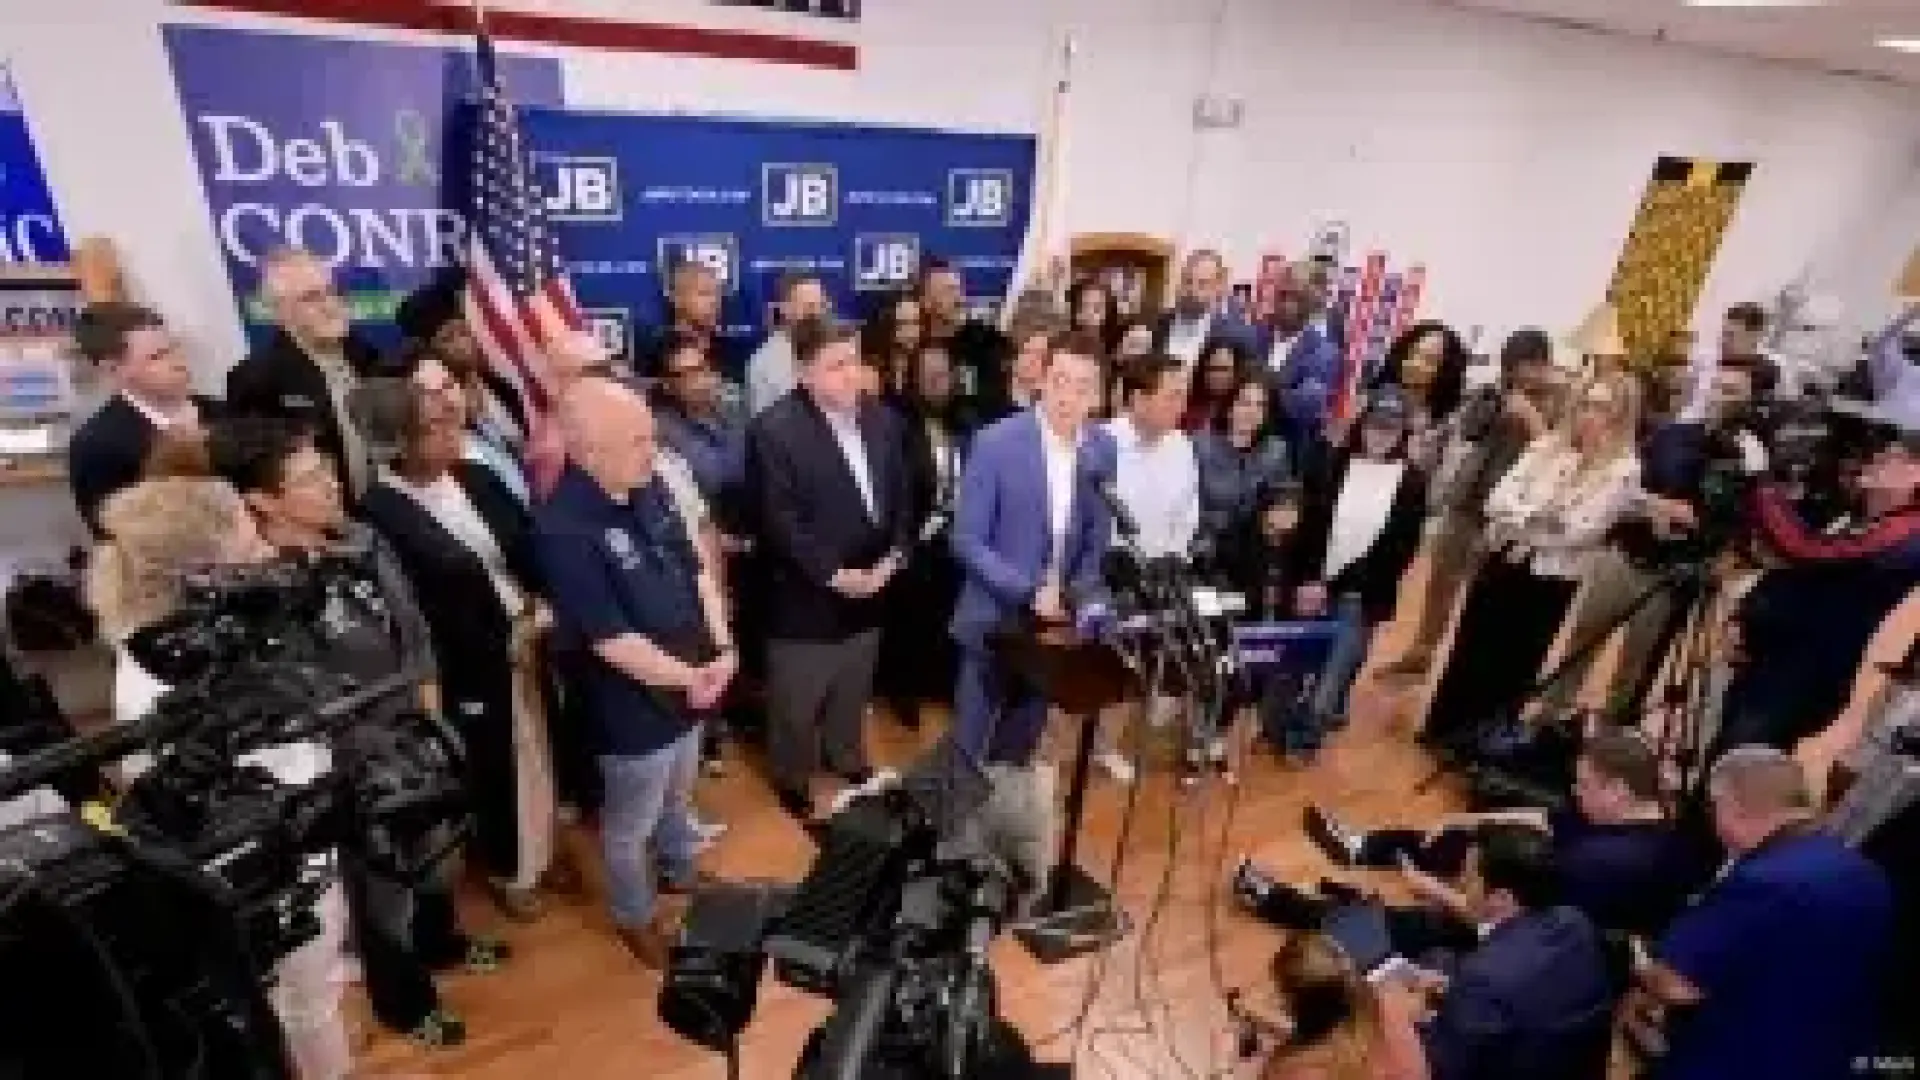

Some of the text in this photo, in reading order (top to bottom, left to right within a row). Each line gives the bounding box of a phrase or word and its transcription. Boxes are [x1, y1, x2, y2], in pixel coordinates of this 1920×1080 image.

[200, 115, 380, 187] Deb
[546, 166, 612, 210] JB
[772, 173, 828, 217] JB
[952, 178, 1003, 217] JB
[859, 243, 908, 281] JB
